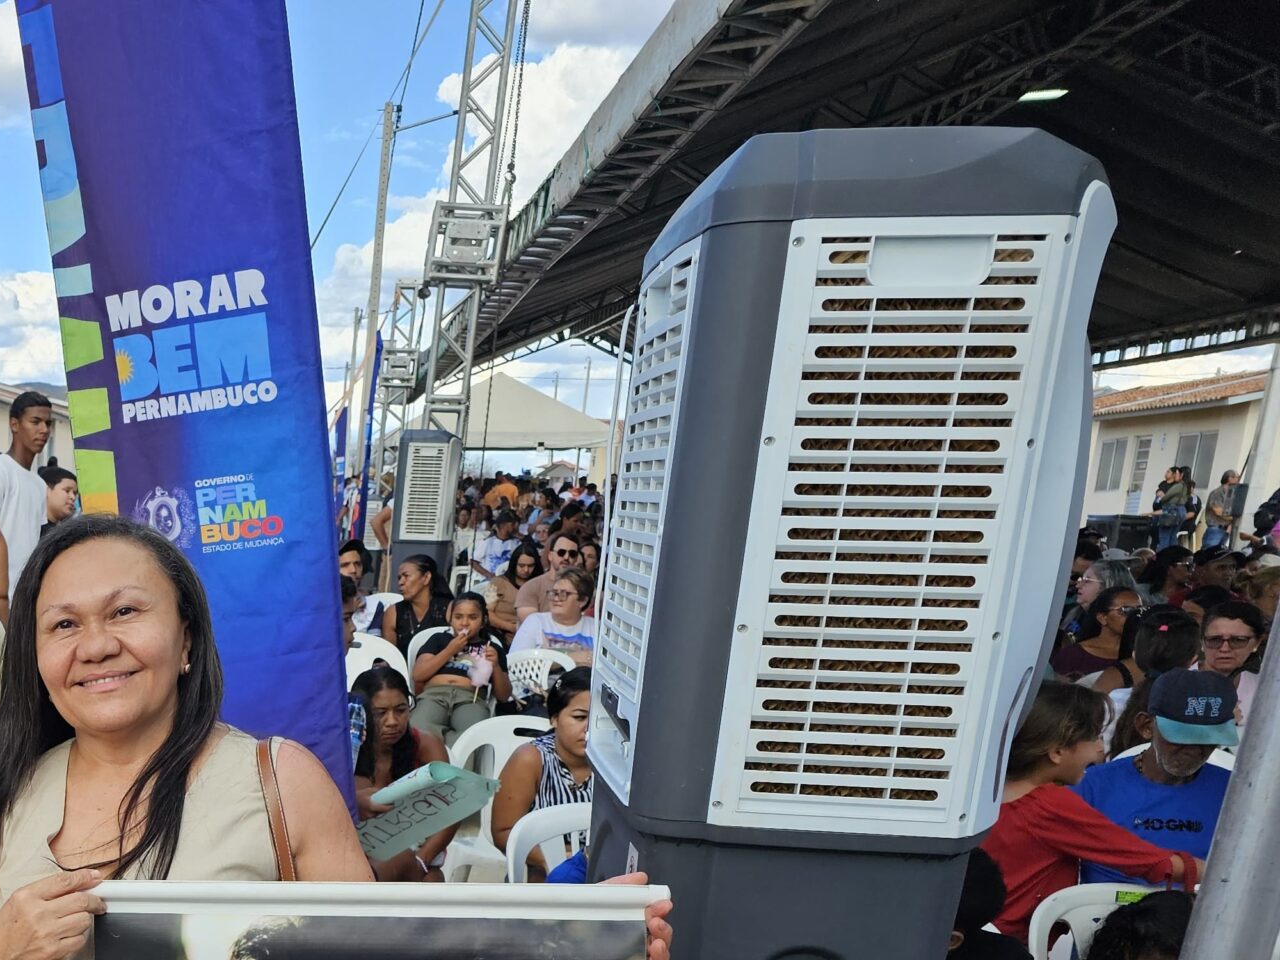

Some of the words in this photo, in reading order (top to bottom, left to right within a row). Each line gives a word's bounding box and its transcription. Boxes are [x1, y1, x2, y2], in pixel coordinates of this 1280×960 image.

[105, 268, 268, 332] MORAR
[113, 312, 272, 401] BEM
[122, 380, 277, 424] PERNAMBUCO
[194, 474, 245, 488] GOVERNO
[245, 472, 255, 481] DE
[196, 482, 257, 507] PER
[198, 499, 266, 525] NAM
[201, 515, 283, 544] BUCO
[202, 543, 231, 553] ESTADO
[232, 542, 243, 550] DE
[244, 537, 284, 549] MUDANÇA
